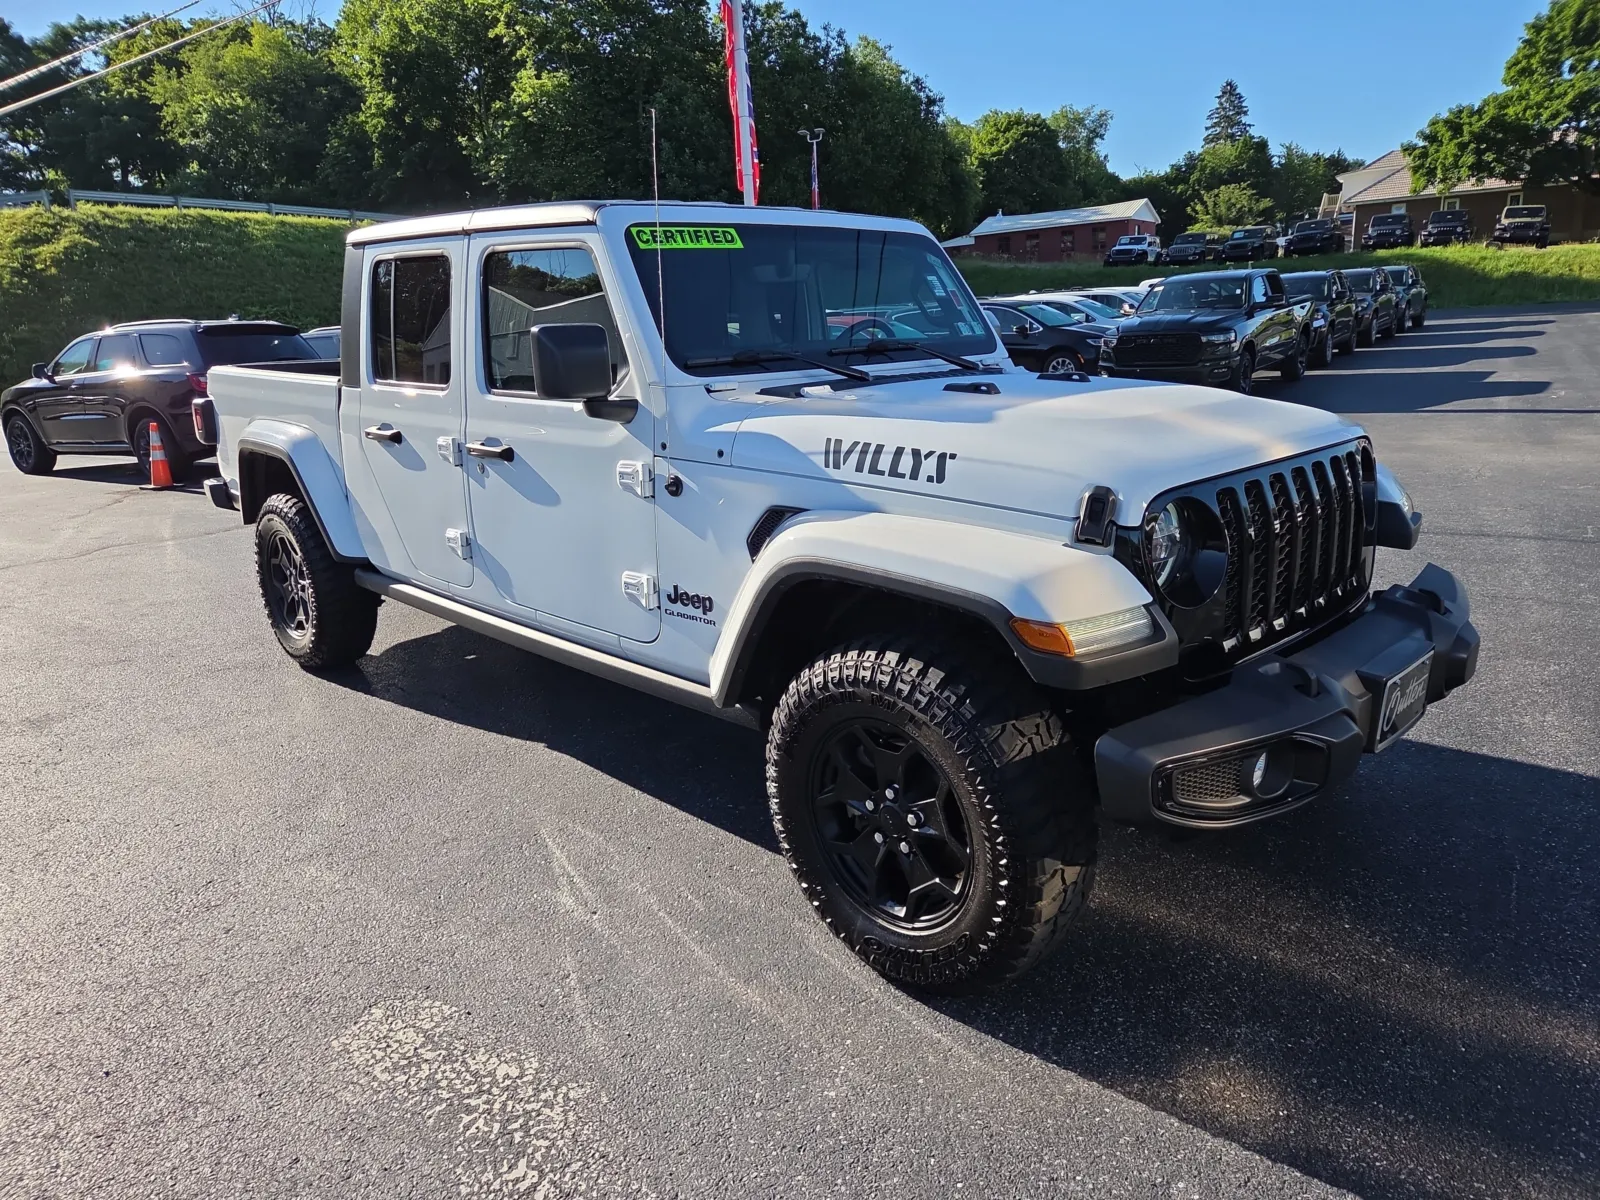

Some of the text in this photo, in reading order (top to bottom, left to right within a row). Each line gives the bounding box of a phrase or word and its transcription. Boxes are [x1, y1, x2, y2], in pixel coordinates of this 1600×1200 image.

[635, 229, 738, 245] CERTIFIED
[824, 437, 958, 485] WILLYS
[667, 584, 714, 615] Jeep
[665, 608, 716, 627] GLADIATOR
